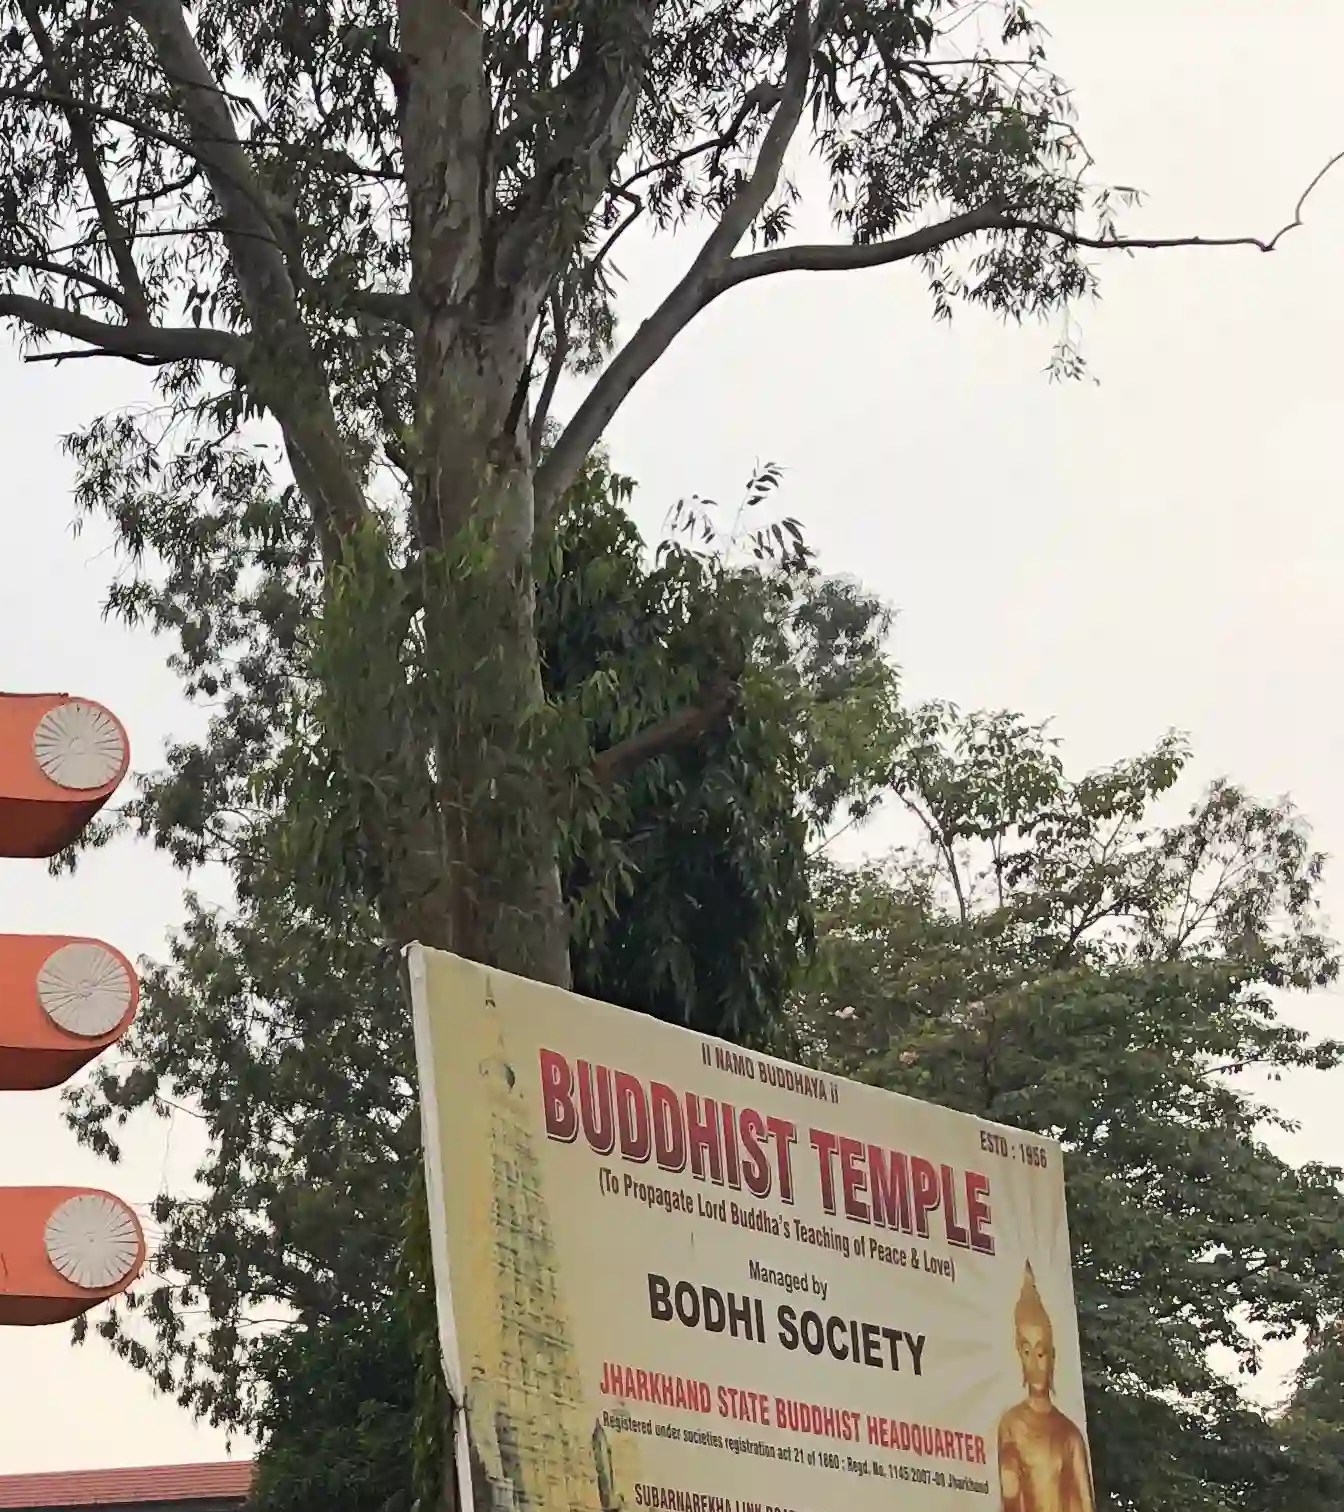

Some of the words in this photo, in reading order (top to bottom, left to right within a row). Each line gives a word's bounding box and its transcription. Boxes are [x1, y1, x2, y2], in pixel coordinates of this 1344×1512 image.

[715, 1046, 755, 1080] NAMO
[758, 1061, 828, 1101] BUDDHAYA
[538, 1047, 797, 1206] BUDDHIST
[809, 1127, 996, 1257] TEMPLE
[1019, 1143, 1048, 1169] 1956
[599, 1167, 620, 1196] (To
[623, 1173, 694, 1213] Propagate
[697, 1193, 727, 1223] Lord
[730, 1201, 791, 1239] Buddha's
[793, 1218, 850, 1258] Teaching
[853, 1235, 866, 1258] of
[869, 1237, 907, 1267] Peace
[911, 1247, 920, 1270] &
[923, 1249, 956, 1284] Love)
[748, 1259, 809, 1294] Managed
[812, 1275, 829, 1301] by
[647, 1273, 766, 1344] BODHI
[777, 1304, 926, 1377] SOCIETY
[600, 1362, 712, 1414] JHARKHAND
[717, 1385, 770, 1426] STATE
[774, 1397, 862, 1443] BUDDHIST
[866, 1415, 987, 1465] HEADQUARTER
[602, 1410, 653, 1435] Registered
[655, 1422, 681, 1441] under
[683, 1428, 724, 1449] societies
[724, 1434, 775, 1458] registration
[777, 1446, 792, 1461] act
[793, 1447, 805, 1464] 21
[807, 1450, 816, 1467] of
